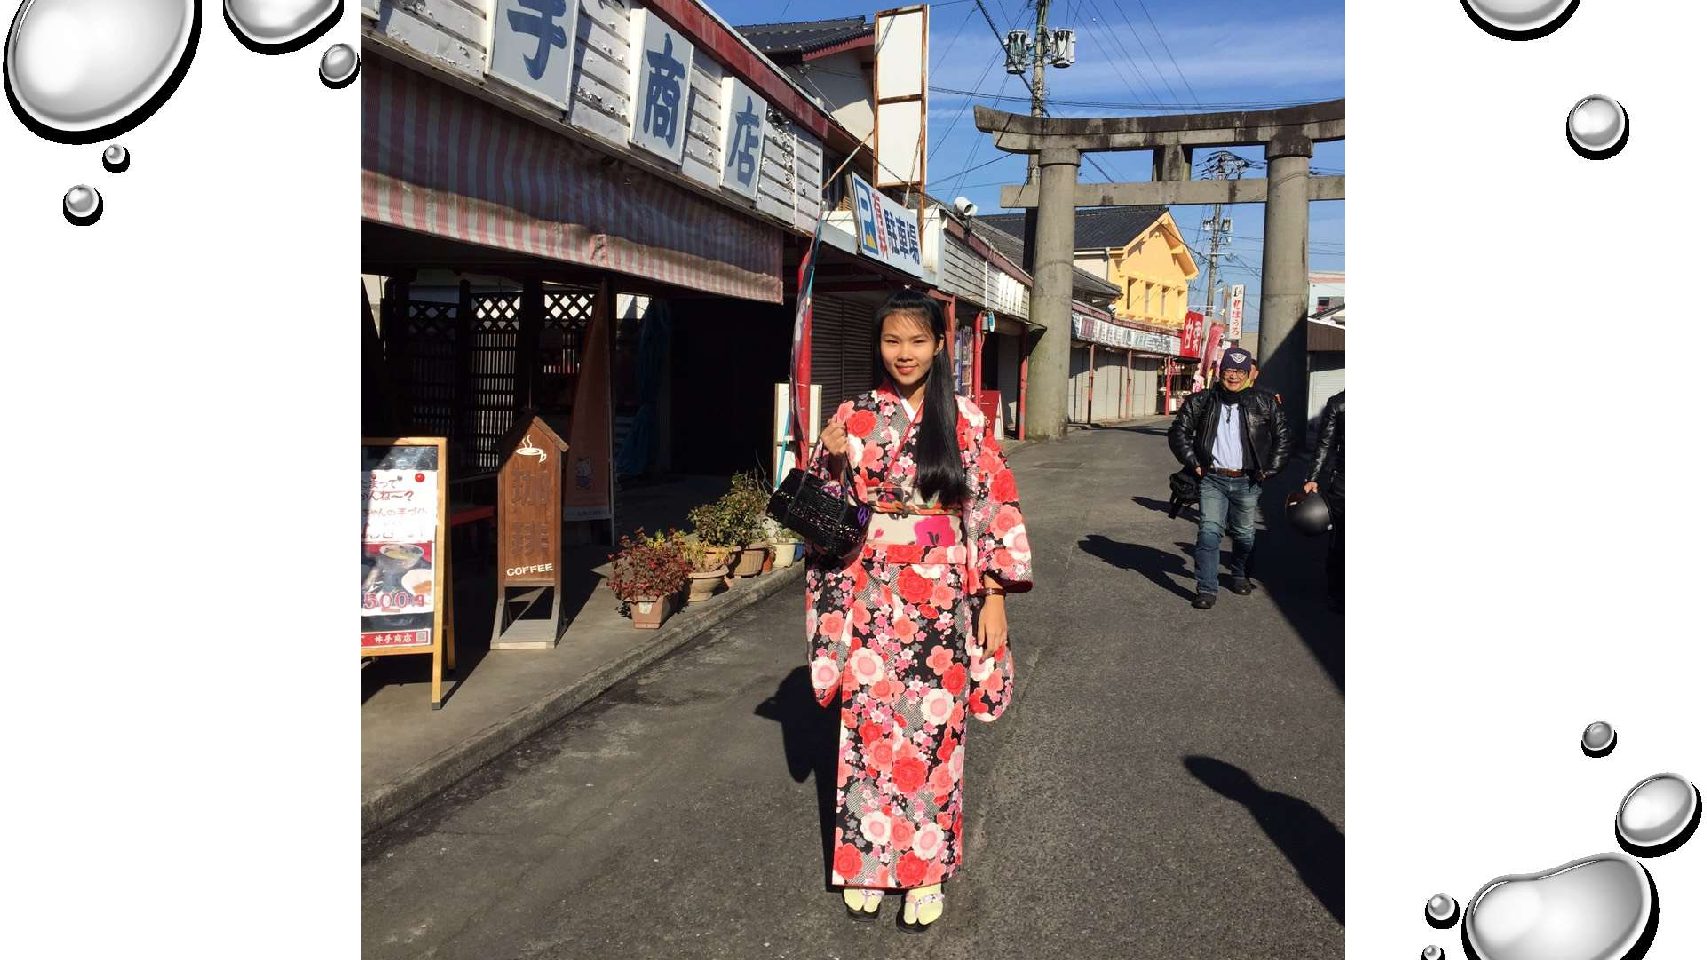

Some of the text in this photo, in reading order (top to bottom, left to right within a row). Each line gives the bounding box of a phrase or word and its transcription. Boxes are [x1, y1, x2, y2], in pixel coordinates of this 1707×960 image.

[883, 208, 921, 265] 駐車場
[506, 562, 554, 577] COFFEE
